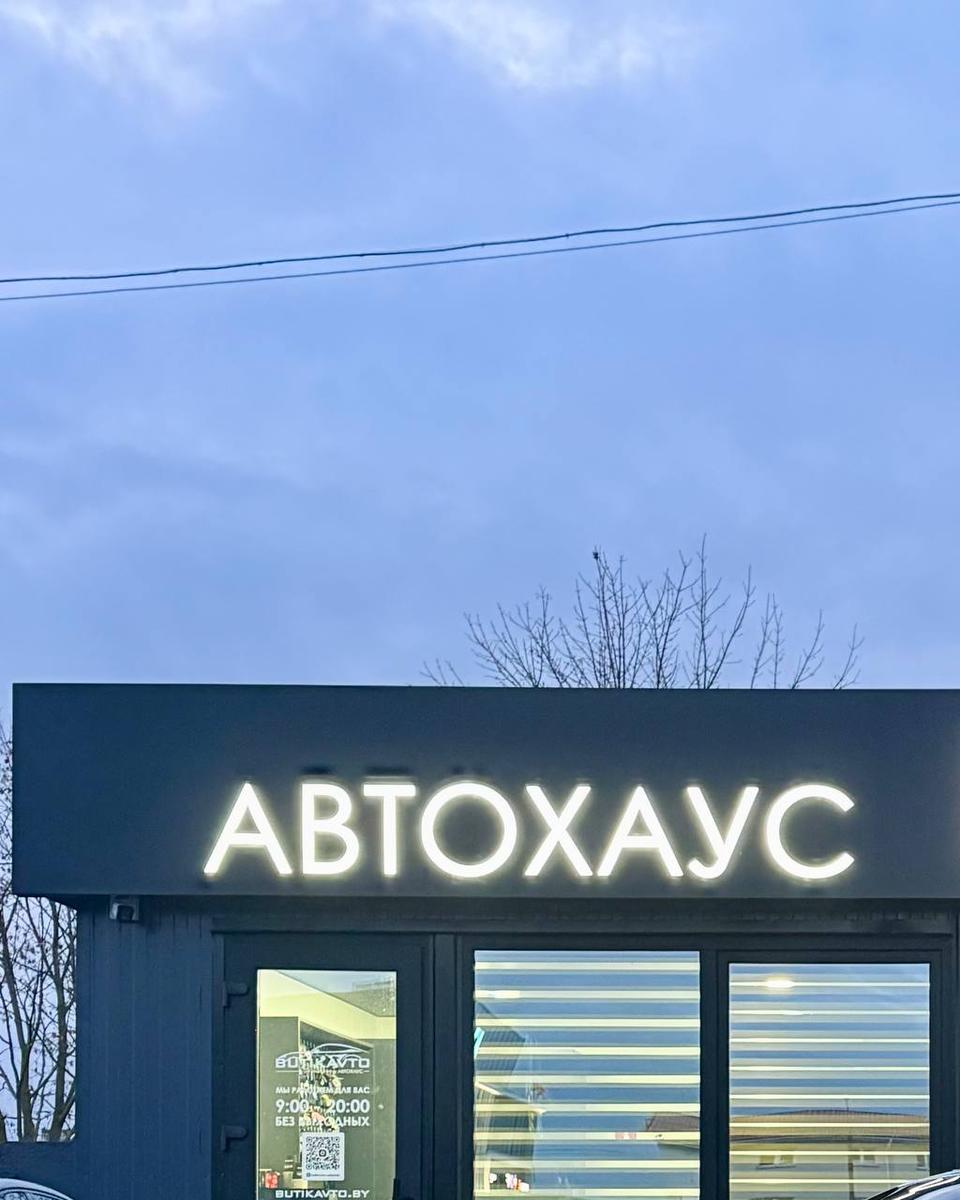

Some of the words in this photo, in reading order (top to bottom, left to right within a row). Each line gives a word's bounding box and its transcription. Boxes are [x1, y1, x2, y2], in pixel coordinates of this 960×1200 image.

[203, 781, 856, 880] АВТОХАУС
[275, 1086, 290, 1094] МЫ
[353, 1086, 370, 1094] ВАС
[275, 1098, 310, 1114] 9:00
[325, 1098, 370, 1114] 20:00
[275, 1116, 295, 1127] БЕЗ
[275, 1189, 370, 1198] BUTIKAVTO.BY
